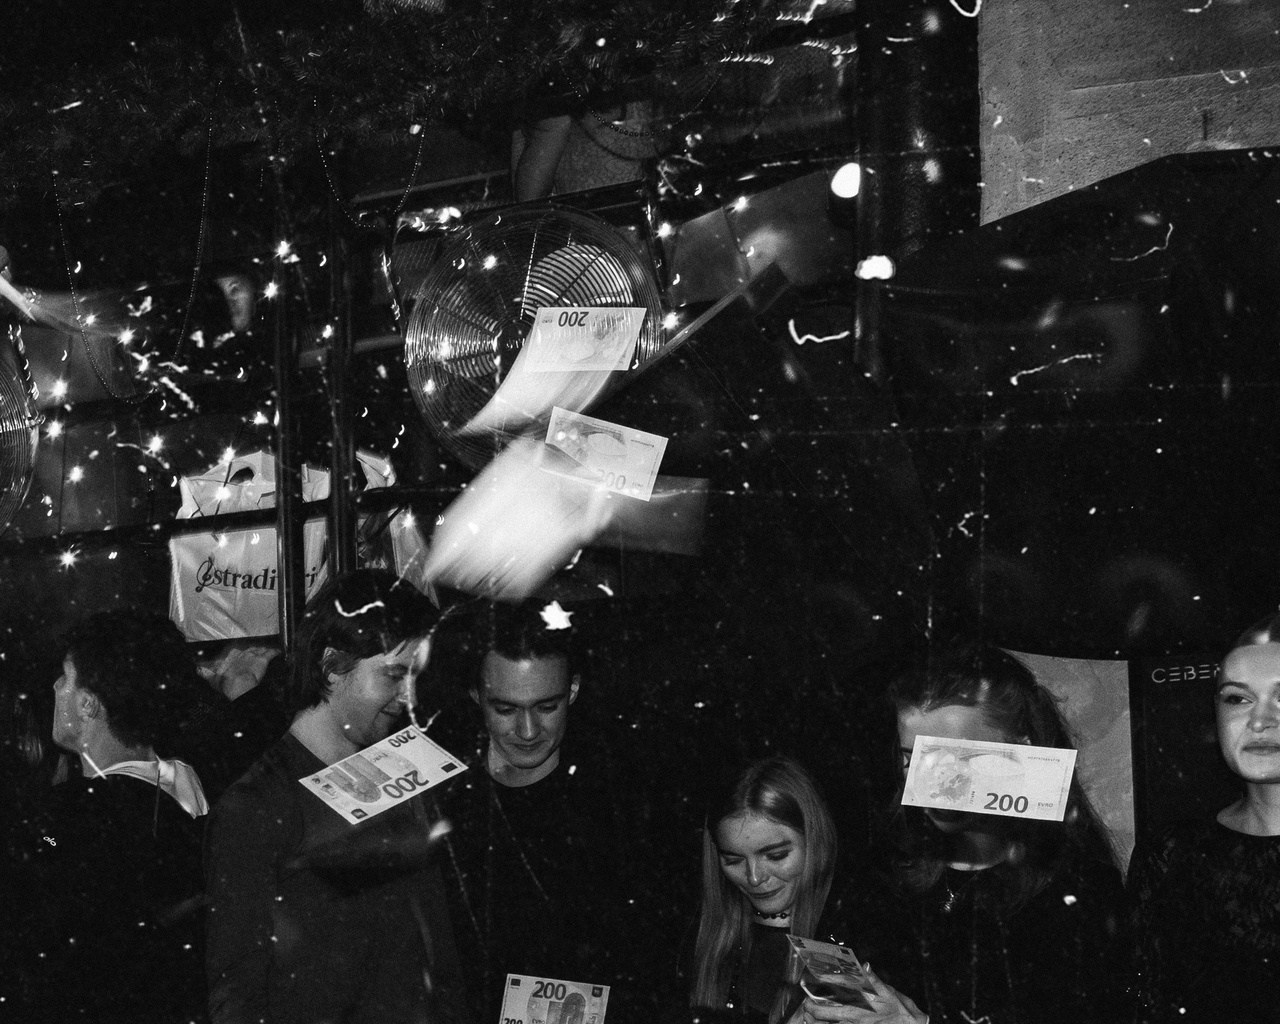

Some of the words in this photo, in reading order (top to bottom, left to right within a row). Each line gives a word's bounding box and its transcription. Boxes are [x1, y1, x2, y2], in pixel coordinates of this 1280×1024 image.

[558, 311, 589, 327] 200
[388, 730, 417, 748] 200
[382, 770, 429, 799] 200
[983, 792, 1029, 813] 200
[532, 981, 567, 1001] 200
